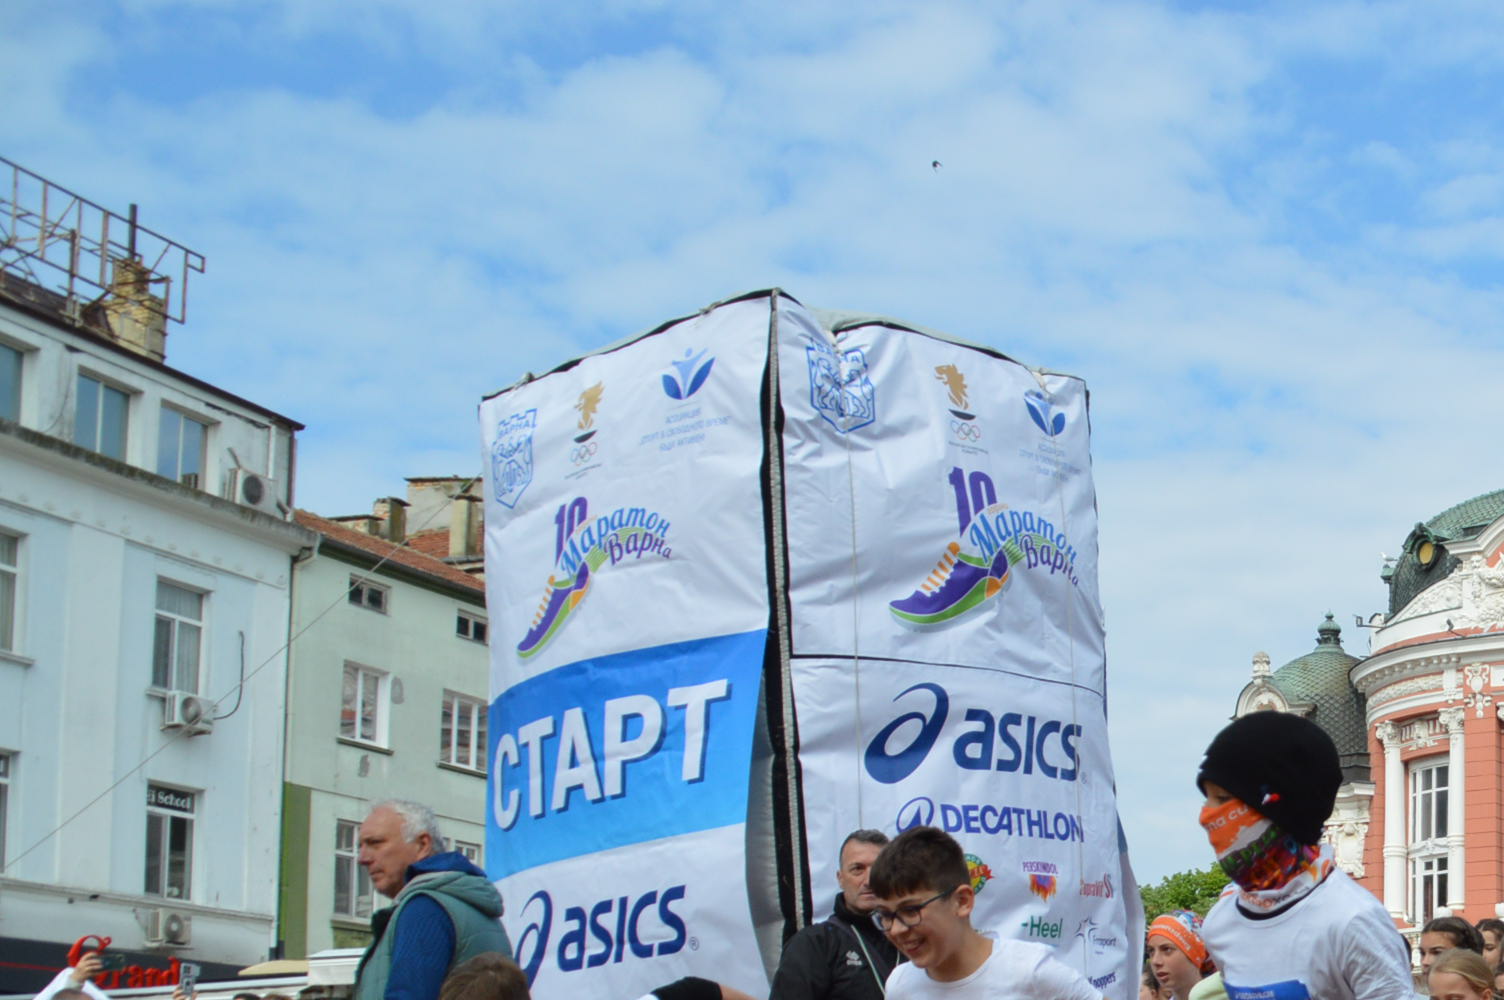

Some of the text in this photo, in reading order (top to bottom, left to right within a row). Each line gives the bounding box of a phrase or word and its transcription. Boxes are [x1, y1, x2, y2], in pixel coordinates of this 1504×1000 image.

[554, 496, 587, 566] 10
[949, 466, 997, 538] 10
[970, 510, 1077, 563] Маратон
[561, 507, 670, 577] Маратон
[605, 533, 672, 566] Варна
[1020, 534, 1078, 587] Варна
[492, 678, 731, 831] СТАРТ
[940, 803, 1085, 842] DECATHLON
[557, 885, 686, 972] asics
